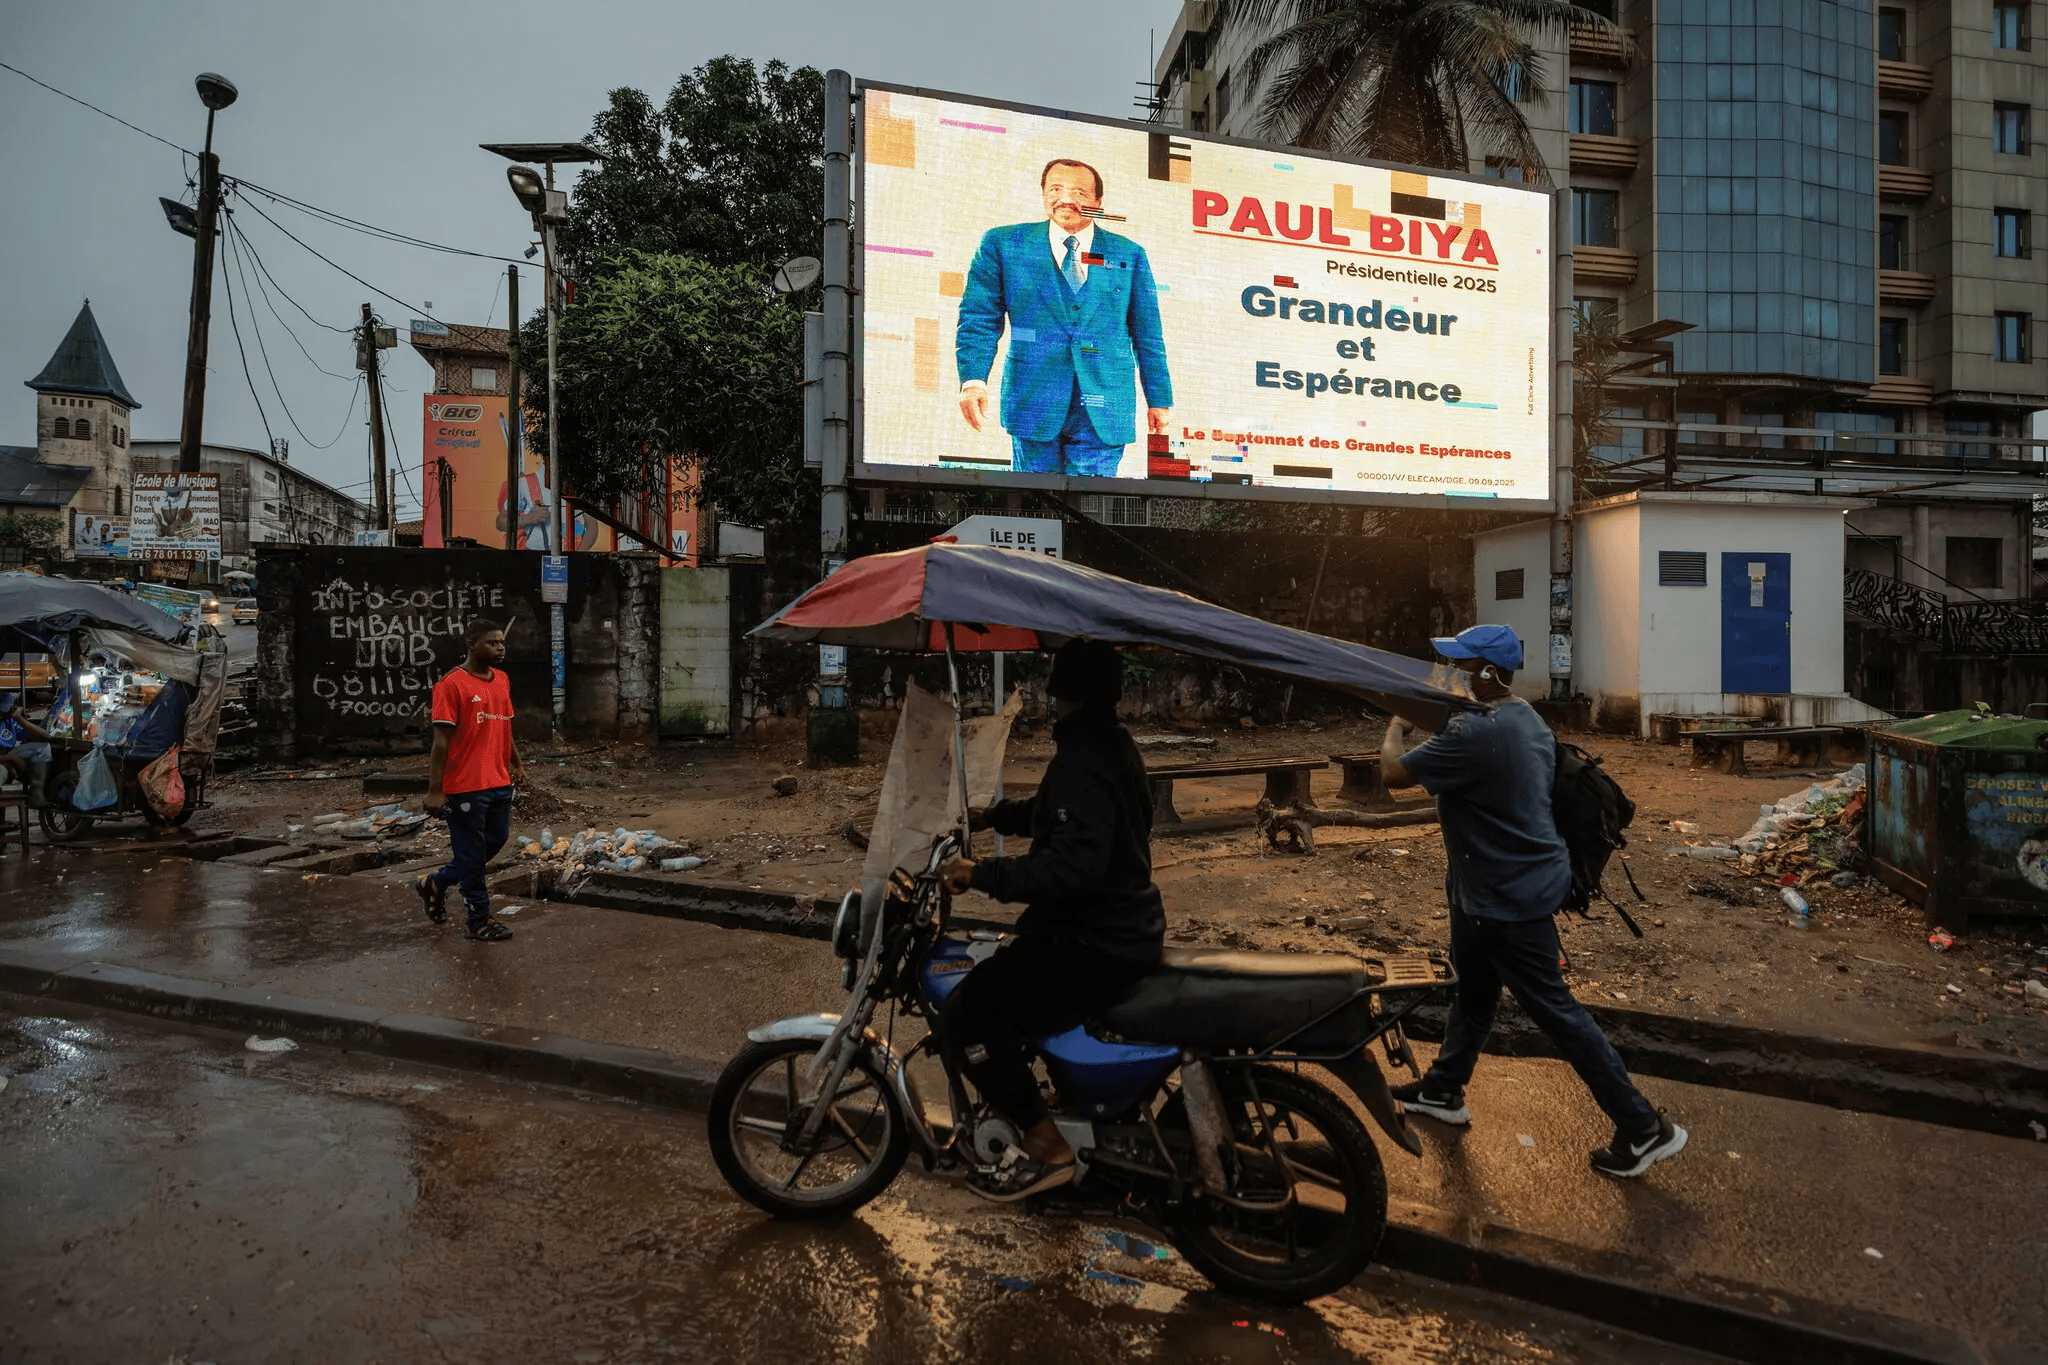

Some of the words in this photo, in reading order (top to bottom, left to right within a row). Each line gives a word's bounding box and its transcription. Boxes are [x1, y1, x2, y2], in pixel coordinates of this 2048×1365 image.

[1193, 189, 1351, 247] PAUL
[1370, 214, 1499, 266] BIYA
[1326, 259, 1448, 288] Présidentielle
[1453, 275, 1497, 294] 2025
[1241, 285, 1458, 336] Grandeur
[1336, 336, 1376, 361] et
[1255, 360, 1462, 403] Espérance
[1183, 427, 1205, 441] Le
[1309, 436, 1340, 450] des
[1345, 438, 1414, 454] Grandes
[1420, 443, 1512, 460] Espérances
[135, 474, 162, 487] Ecole
[164, 474, 176, 487] de
[178, 474, 217, 490] Musique
[990, 528, 1013, 543] ÎLE
[1017, 532, 1035, 544] DE
[145, 549, 151, 559] 6
[153, 550, 164, 559] 78
[167, 550, 178, 559] 01
[181, 550, 192, 559] 13
[194, 550, 206, 559] 50
[356, 633, 436, 668] JOB
